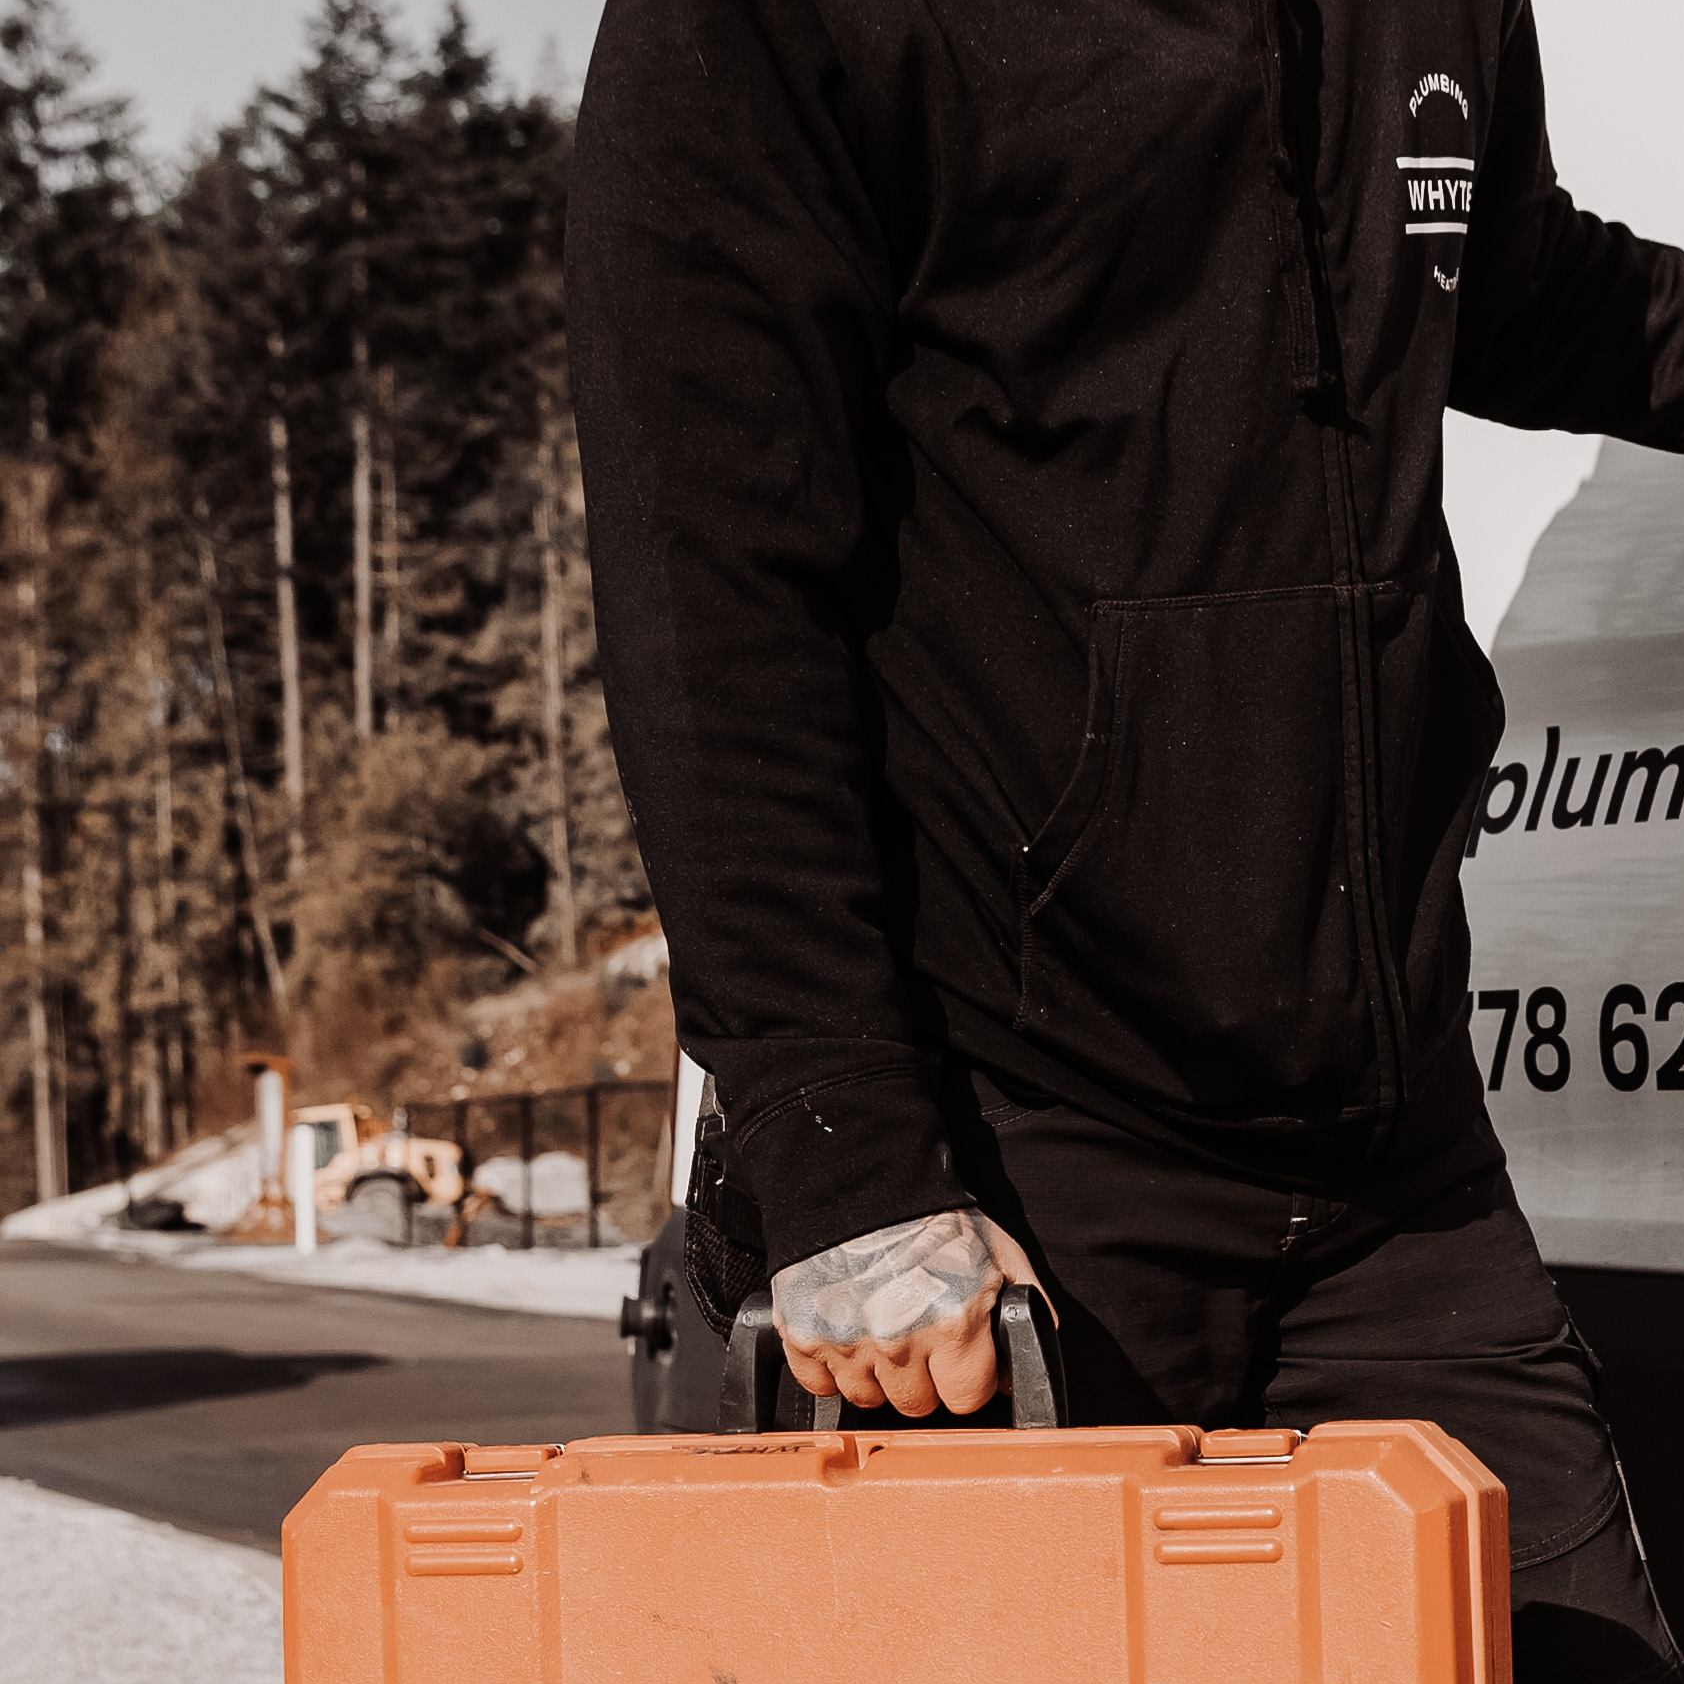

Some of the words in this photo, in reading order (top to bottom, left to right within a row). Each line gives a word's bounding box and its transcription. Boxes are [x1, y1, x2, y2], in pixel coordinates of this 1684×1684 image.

[1409, 73, 1469, 120] PLUMBING
[1408, 179, 1473, 212] WHYTE
[1467, 985, 1571, 1092] 78
